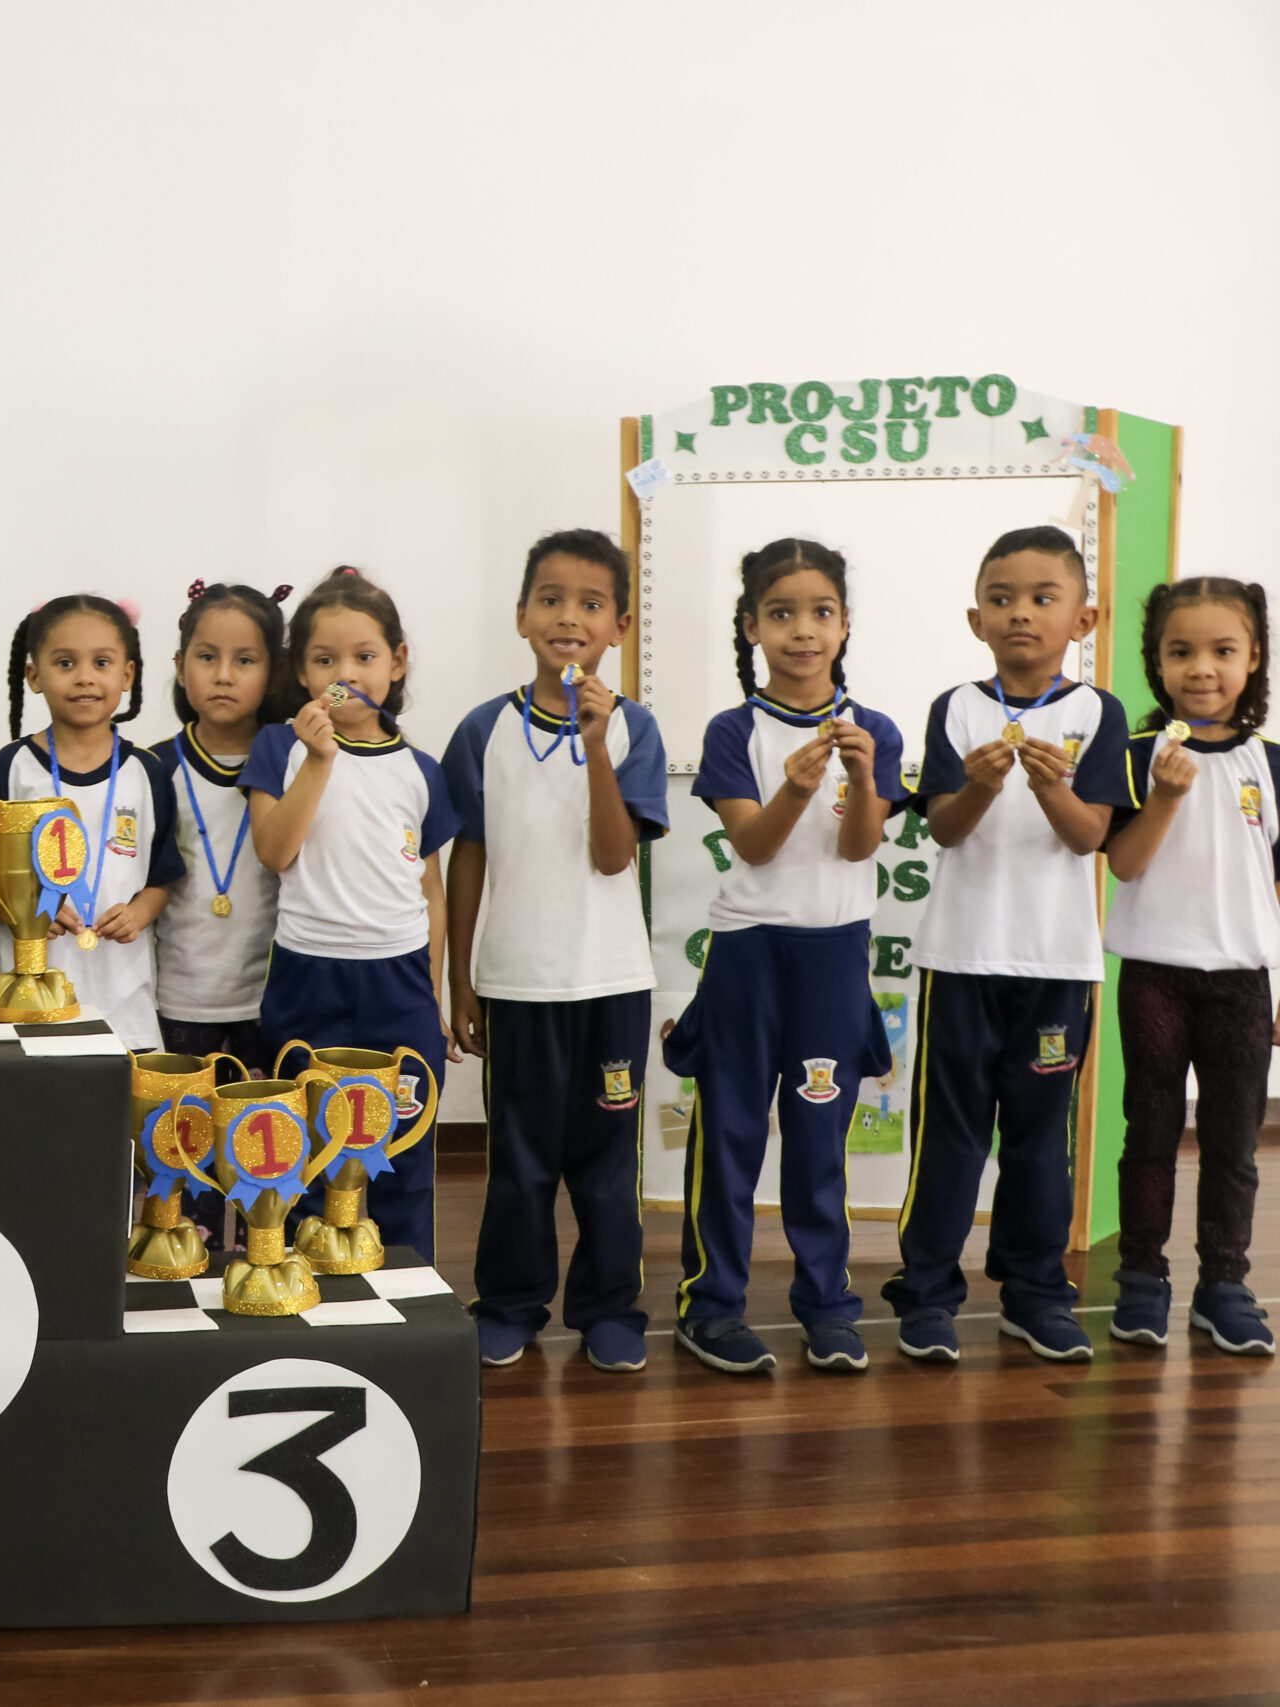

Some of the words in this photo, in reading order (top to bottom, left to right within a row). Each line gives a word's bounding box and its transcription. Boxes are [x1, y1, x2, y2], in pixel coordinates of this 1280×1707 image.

[710, 373, 1017, 426] PROJETO
[784, 419, 932, 466] CSU
[50, 817, 77, 878] 1
[170, 1120, 198, 1155] 1
[247, 1112, 289, 1176] 1
[344, 1088, 376, 1145] 1
[209, 1386, 367, 1592] 3
